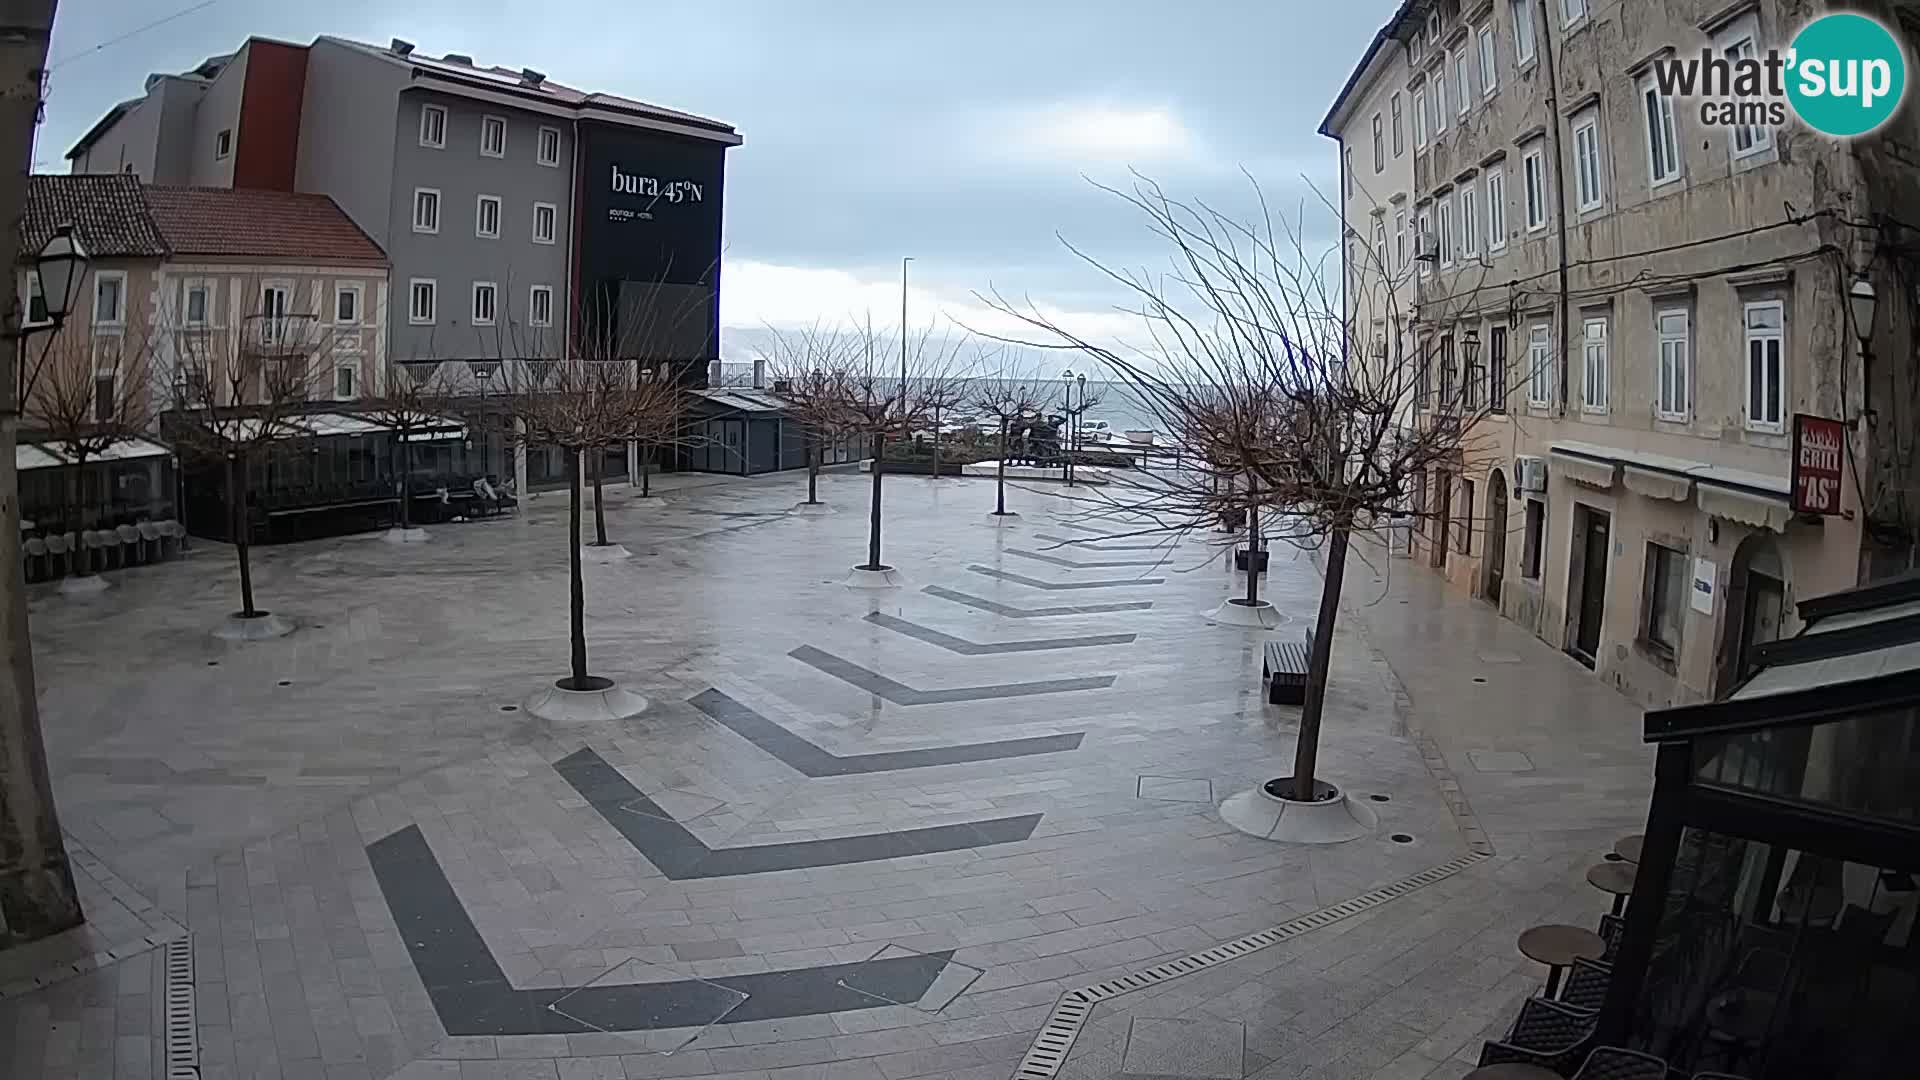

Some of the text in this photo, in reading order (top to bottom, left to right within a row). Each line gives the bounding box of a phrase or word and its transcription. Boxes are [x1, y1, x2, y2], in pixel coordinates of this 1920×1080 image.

[612, 165, 659, 197] bura
[609, 208, 653, 220] BOUTIQUE HOTEL
[1800, 447, 1839, 471] GRILL
[1799, 476, 1838, 509] "AS"
